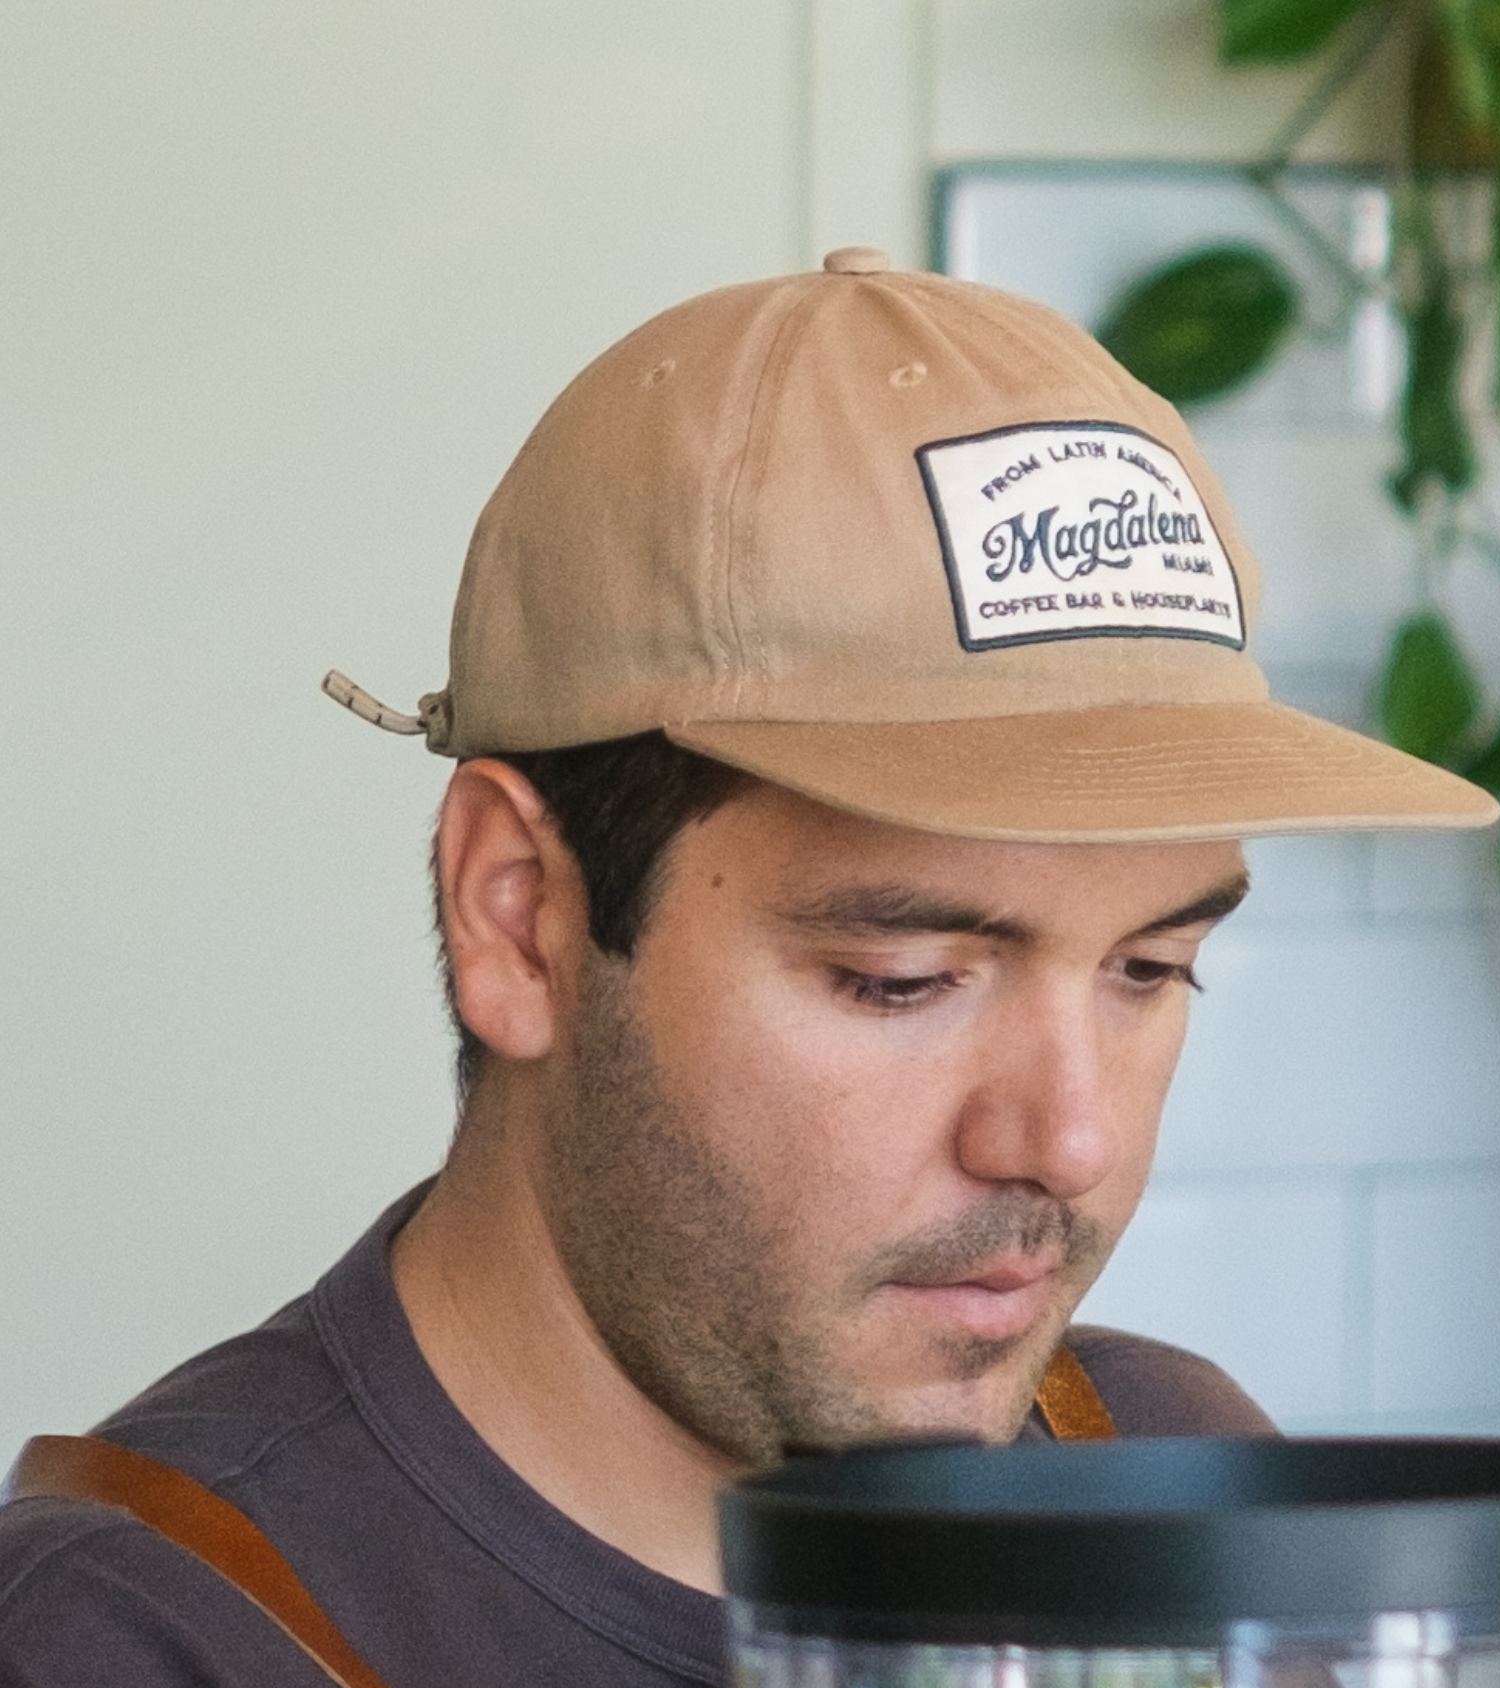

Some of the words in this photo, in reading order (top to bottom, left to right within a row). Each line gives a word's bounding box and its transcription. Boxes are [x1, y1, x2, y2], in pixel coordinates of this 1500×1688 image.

[980, 453, 1042, 502] FROM
[1047, 441, 1107, 463] LATIN
[981, 489, 1206, 582] Magdalena
[1161, 553, 1214, 577] MIAMI
[979, 593, 1062, 619] COFFEE
[1065, 592, 1105, 610] BAR
[1111, 590, 1126, 608] &
